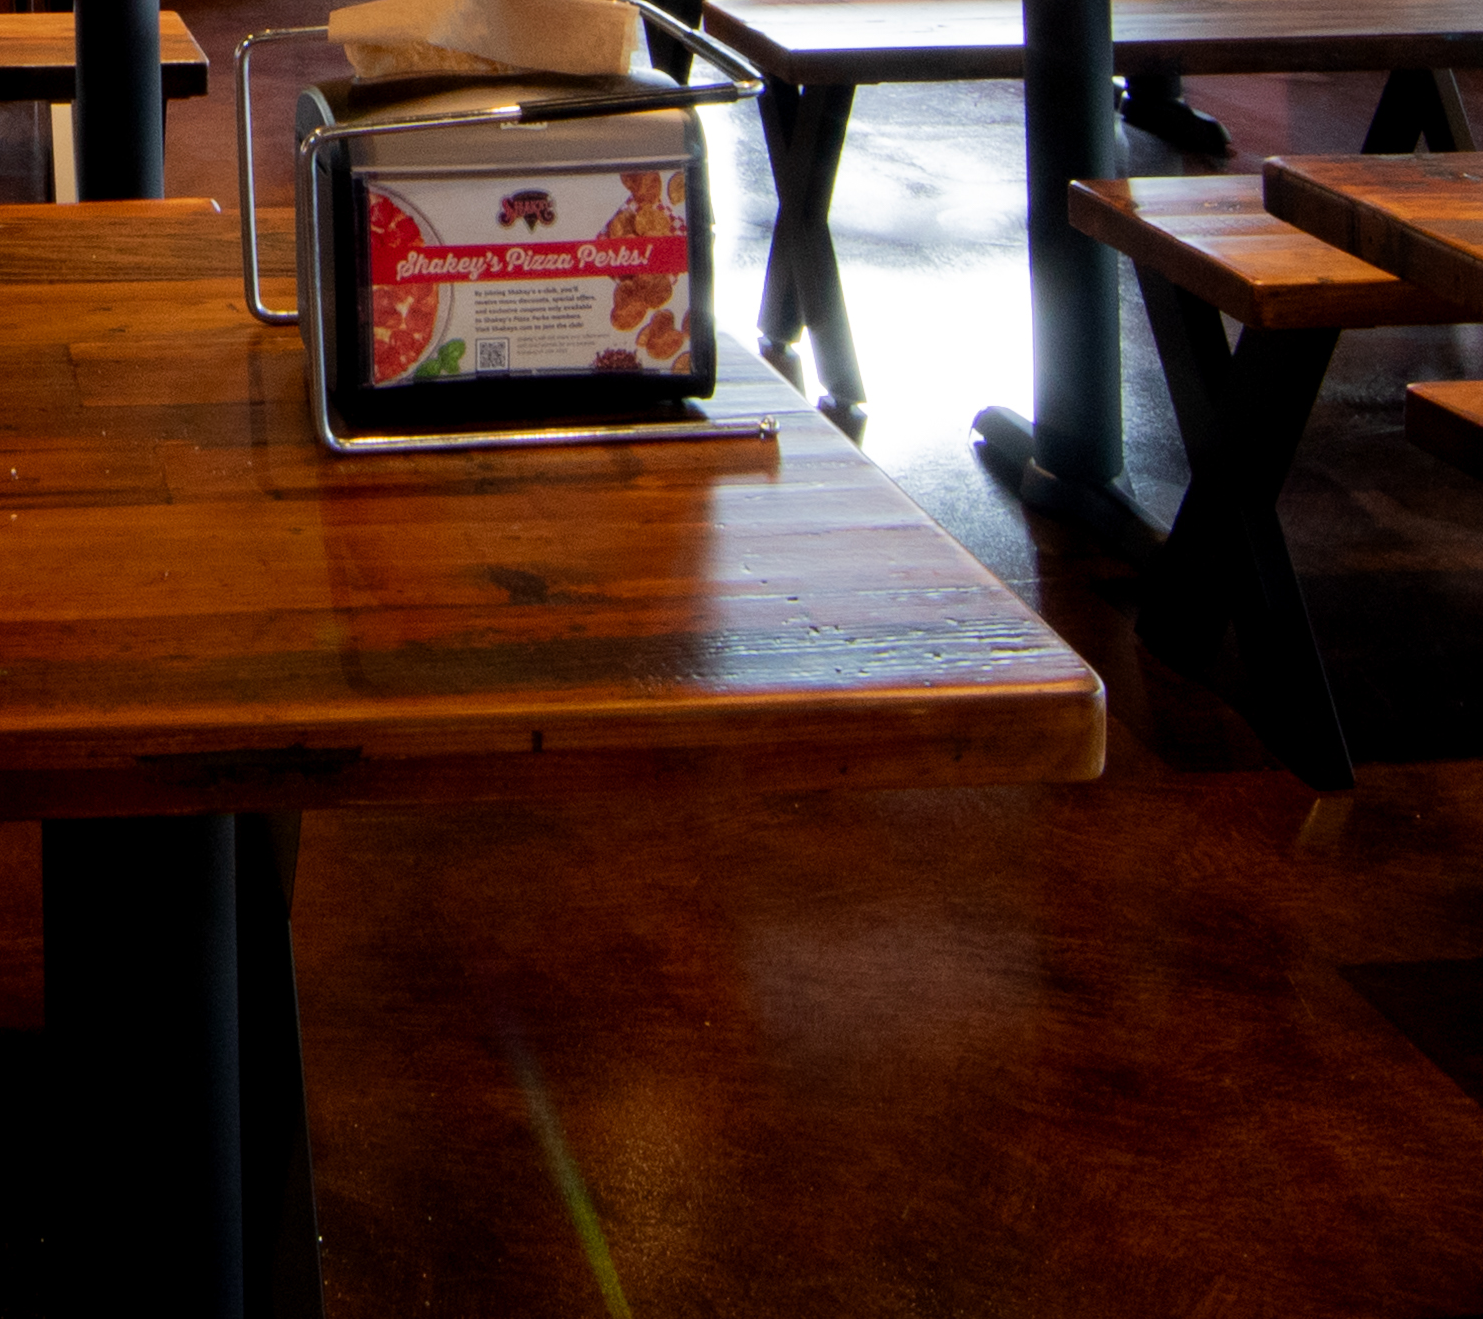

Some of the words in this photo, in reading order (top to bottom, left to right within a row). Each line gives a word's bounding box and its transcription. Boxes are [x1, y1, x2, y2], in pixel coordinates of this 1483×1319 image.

[395, 249, 504, 282] Shakey's
[505, 247, 575, 272] Pizza
[576, 243, 654, 269] Perks!
